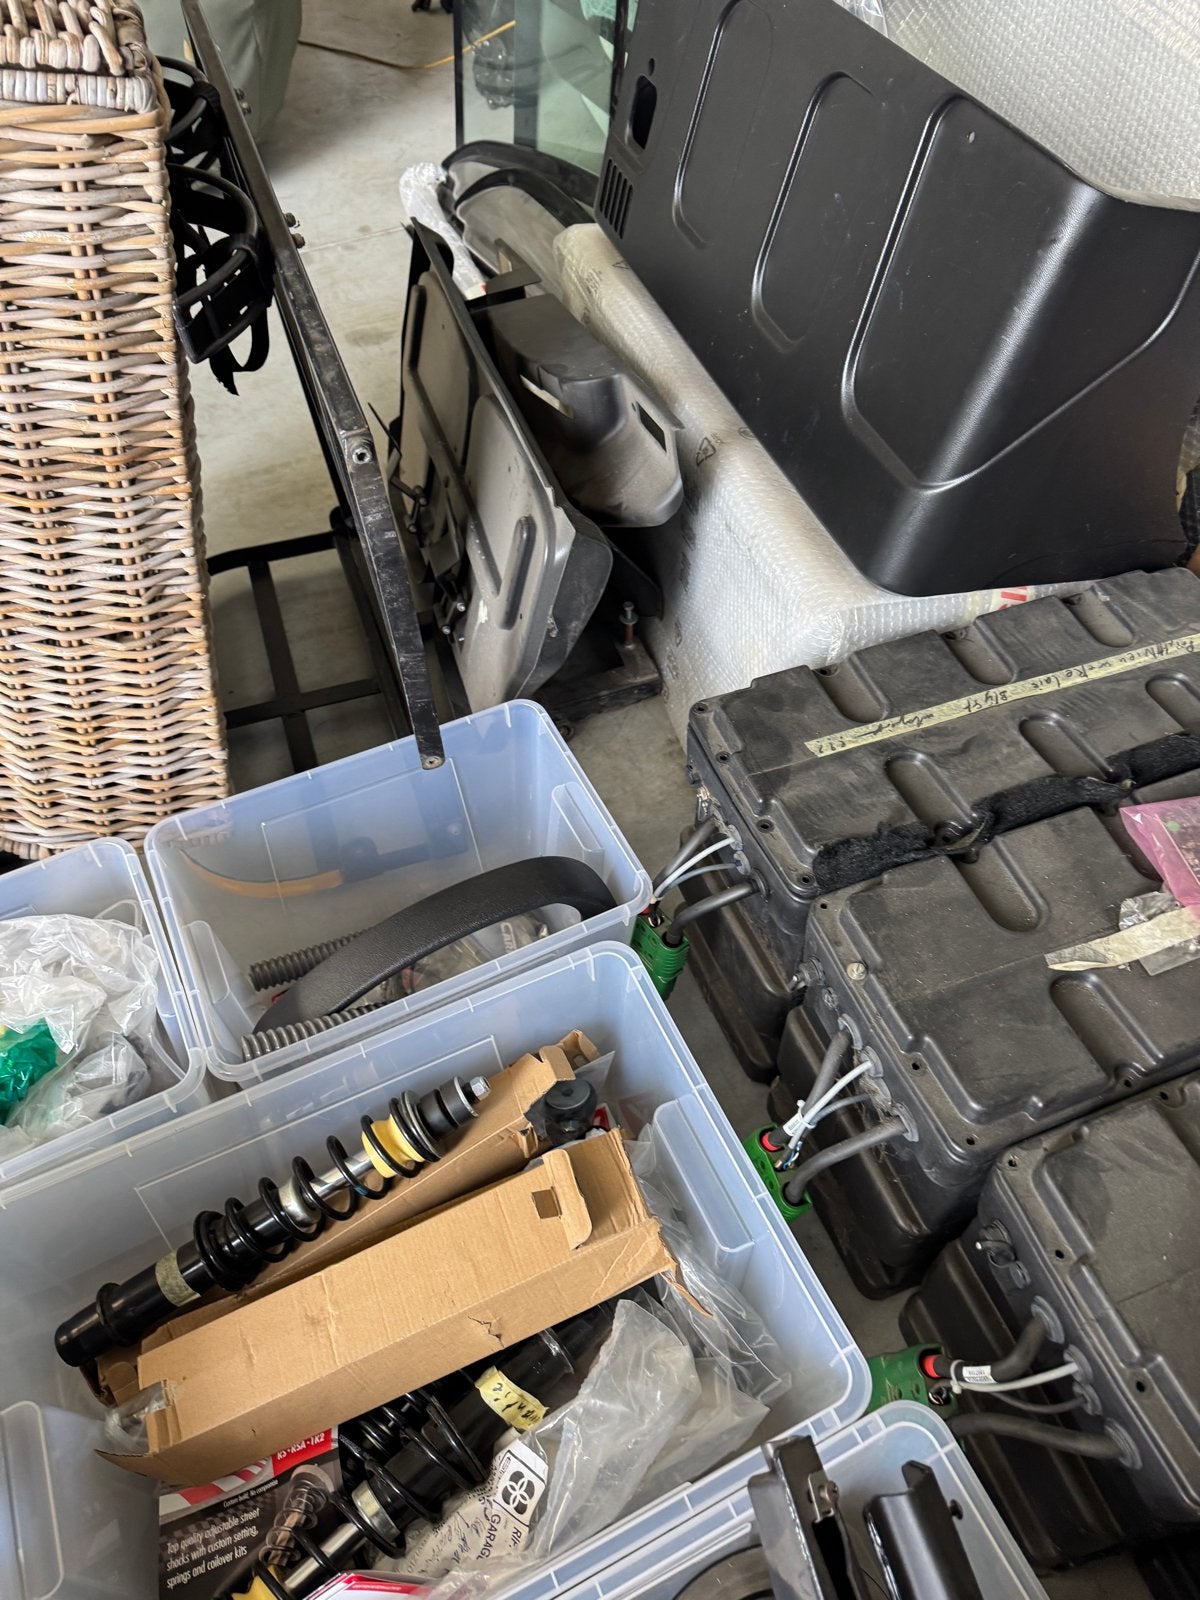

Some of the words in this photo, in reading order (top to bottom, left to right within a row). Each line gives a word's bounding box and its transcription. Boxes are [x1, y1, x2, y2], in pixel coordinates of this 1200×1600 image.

[167, 1542, 180, 1555] Top
[180, 1531, 203, 1551] quality
[204, 1515, 239, 1539] adjustable
[240, 1507, 260, 1523] street
[166, 1555, 190, 1572] shocks
[191, 1547, 206, 1564] with
[207, 1538, 232, 1556] custom
[166, 1571, 191, 1590] springs
[192, 1562, 206, 1577] and
[207, 1552, 233, 1570] coilover
[234, 1545, 248, 1560] kits
